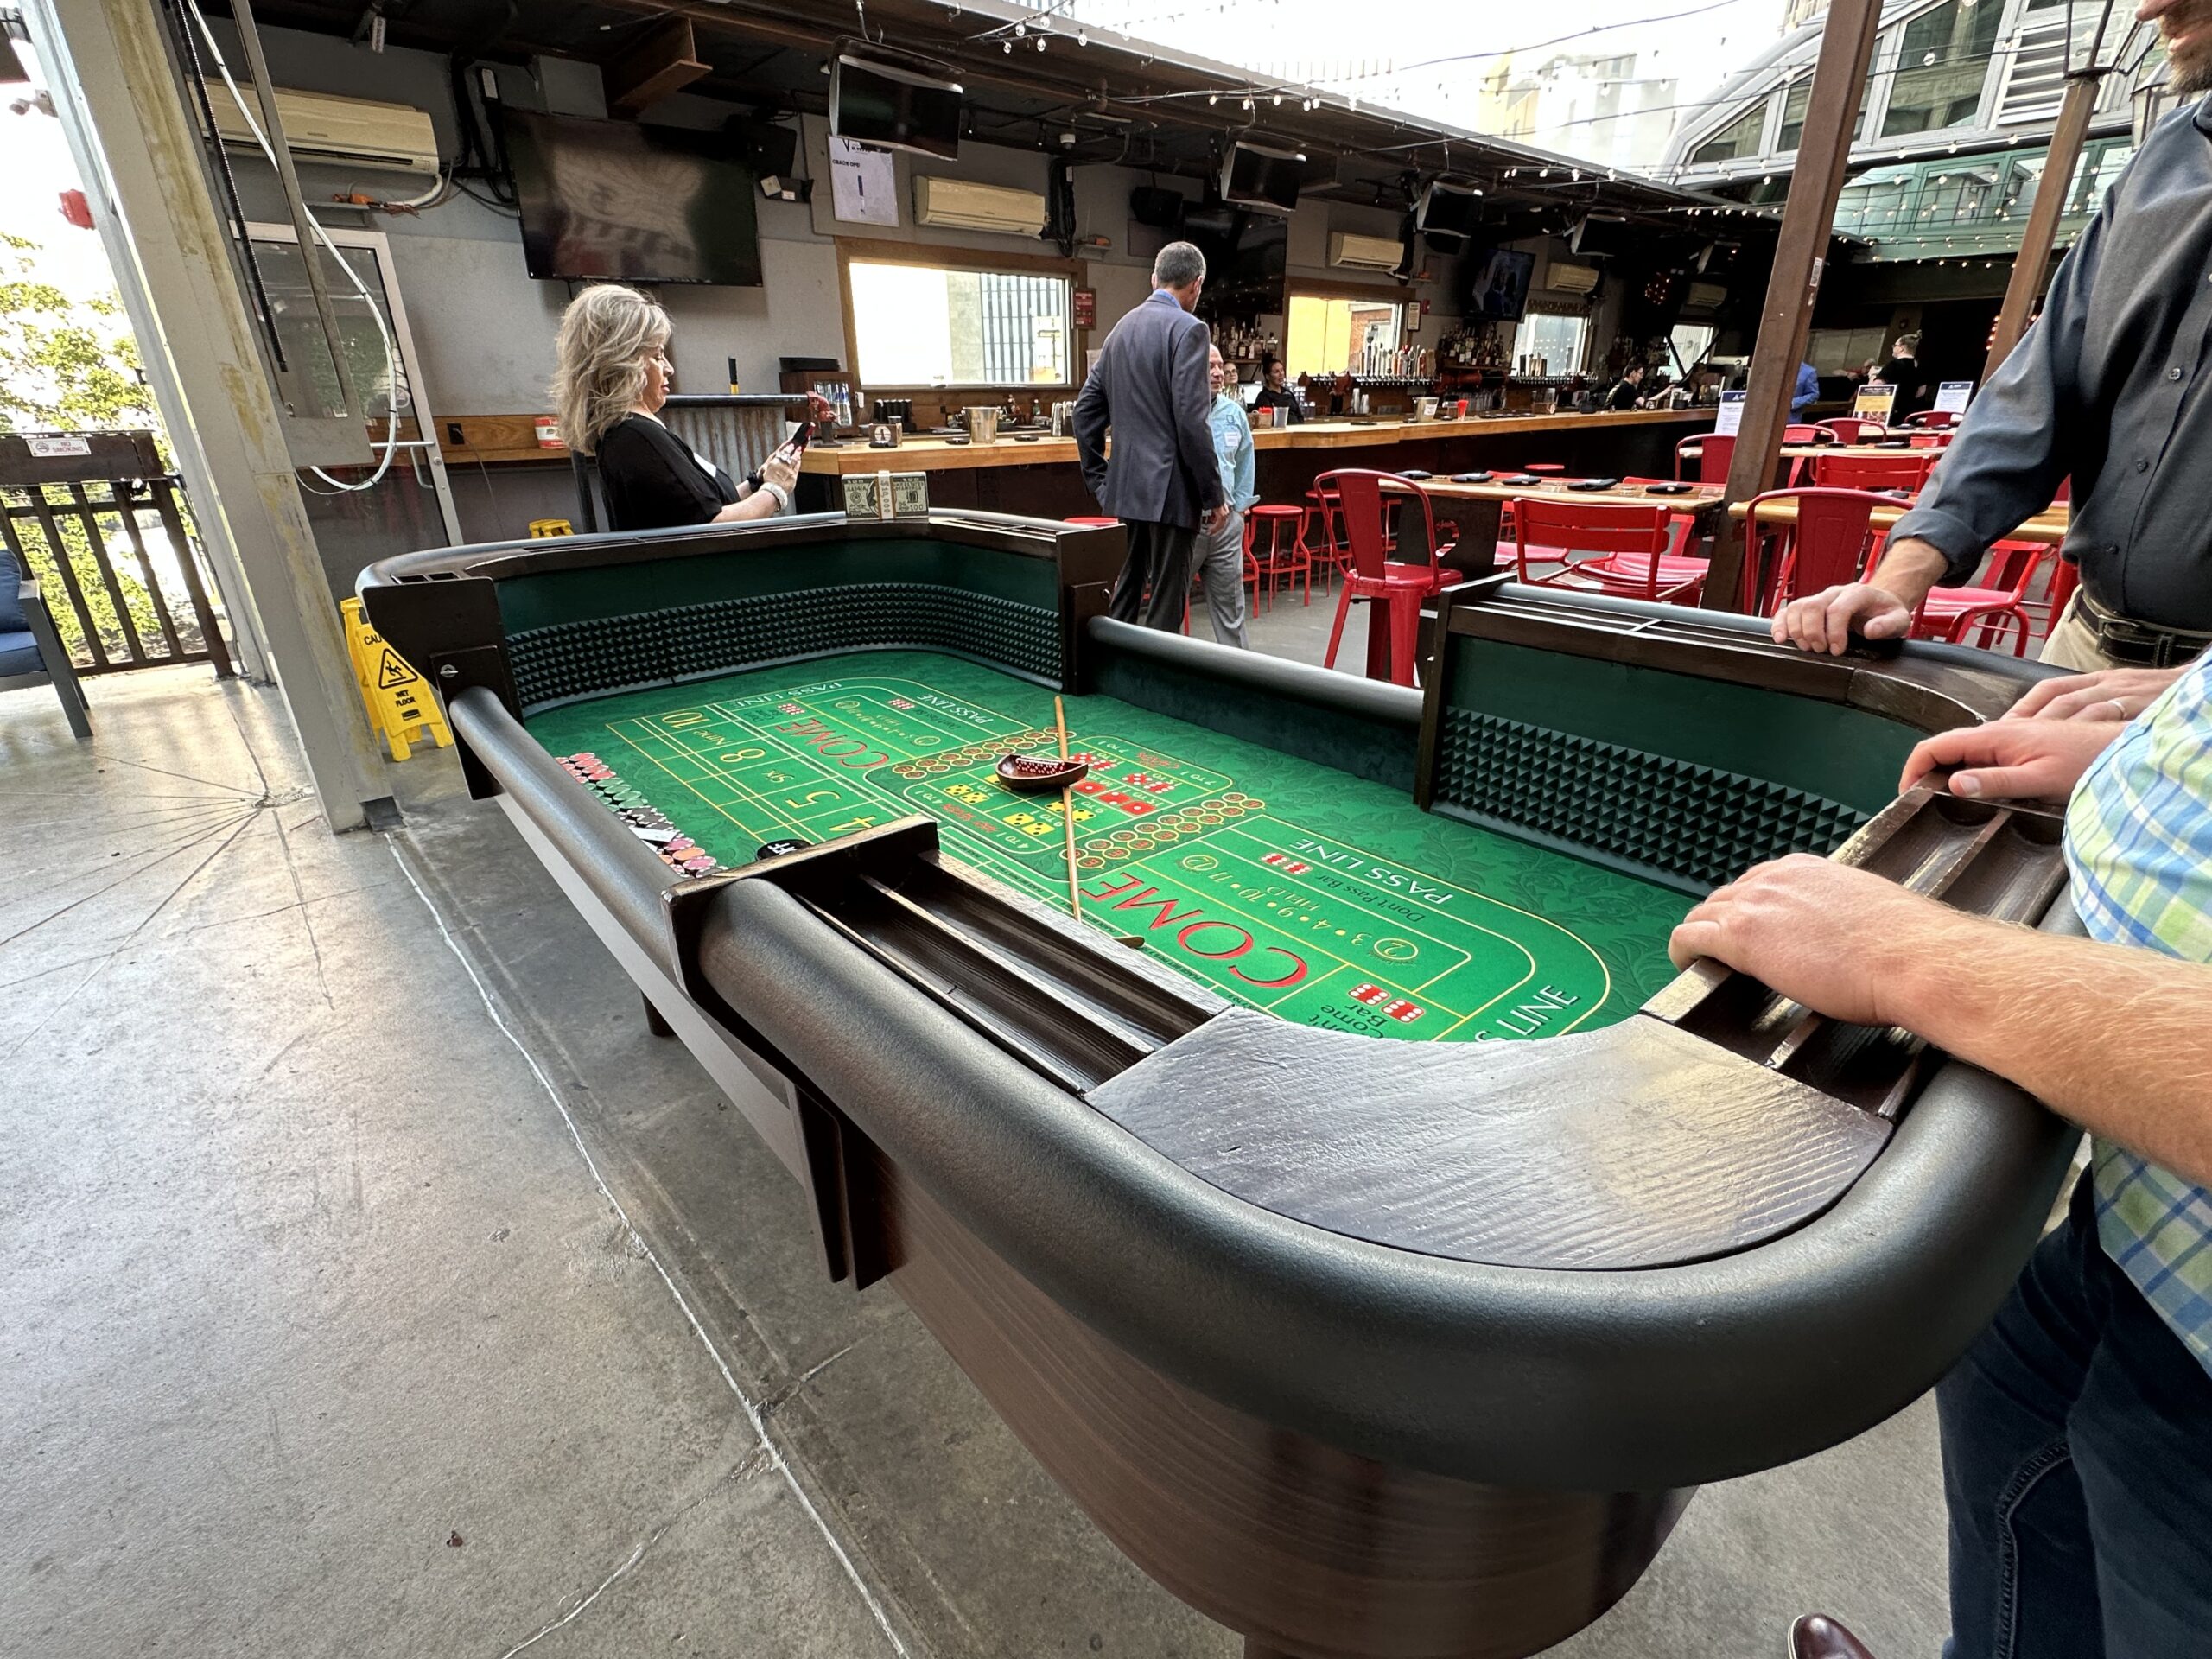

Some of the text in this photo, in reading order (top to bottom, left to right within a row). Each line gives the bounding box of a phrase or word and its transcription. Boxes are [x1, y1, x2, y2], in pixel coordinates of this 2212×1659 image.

[395, 689, 410, 698] WET
[395, 696, 416, 707] FLOOR
[916, 694, 995, 724] PASS LINE
[662, 712, 710, 729] 10
[775, 718, 890, 769] COME
[720, 748, 766, 763] 8
[785, 791, 841, 809] 5
[829, 816, 877, 831] 4
[1039, 814, 1056, 823] TO
[1005, 836, 1020, 844] TO
[766, 842, 798, 855] FF
[1207, 871, 1234, 882] 11
[1289, 838, 1454, 904] PASS LINE
[1237, 887, 1266, 903] 10
[1266, 886, 1321, 911] FIELD
[1314, 874, 1426, 923] Don't Pass Bar
[1276, 905, 1299, 918] 9
[1077, 872, 1308, 988] COME
[1312, 919, 1332, 930] 4
[1351, 932, 1372, 946] 3
[1384, 942, 1406, 957] 2
[1182, 967, 1202, 982] PLACE
[1344, 1004, 1388, 1027] Bar
[1496, 985, 1578, 1036] LINE
[1320, 1004, 1384, 1039] Come
